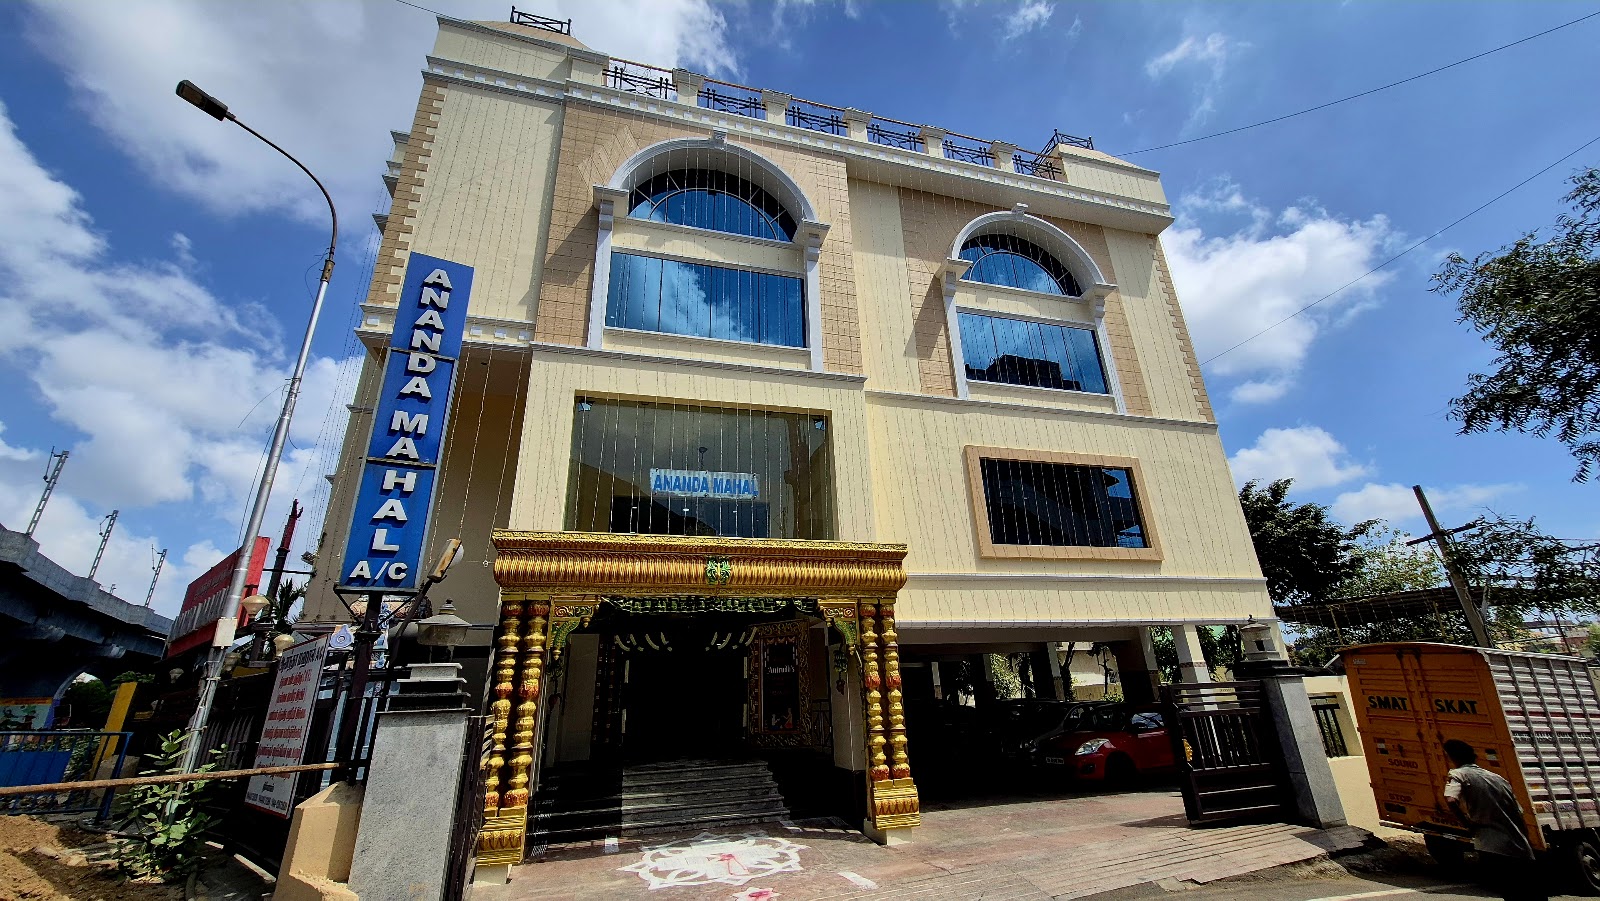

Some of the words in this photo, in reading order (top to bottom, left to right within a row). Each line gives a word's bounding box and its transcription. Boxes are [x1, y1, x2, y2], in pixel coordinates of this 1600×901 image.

[399, 268, 452, 400] ANANDA
[371, 409, 429, 552] MAHAL
[653, 475, 709, 493] ANANDA
[713, 478, 759, 497] MAHAL
[348, 560, 408, 581] A/C
[1367, 695, 1408, 711] SMAT
[1434, 699, 1478, 714] SKAT
[1388, 758, 1418, 769] SOUND
